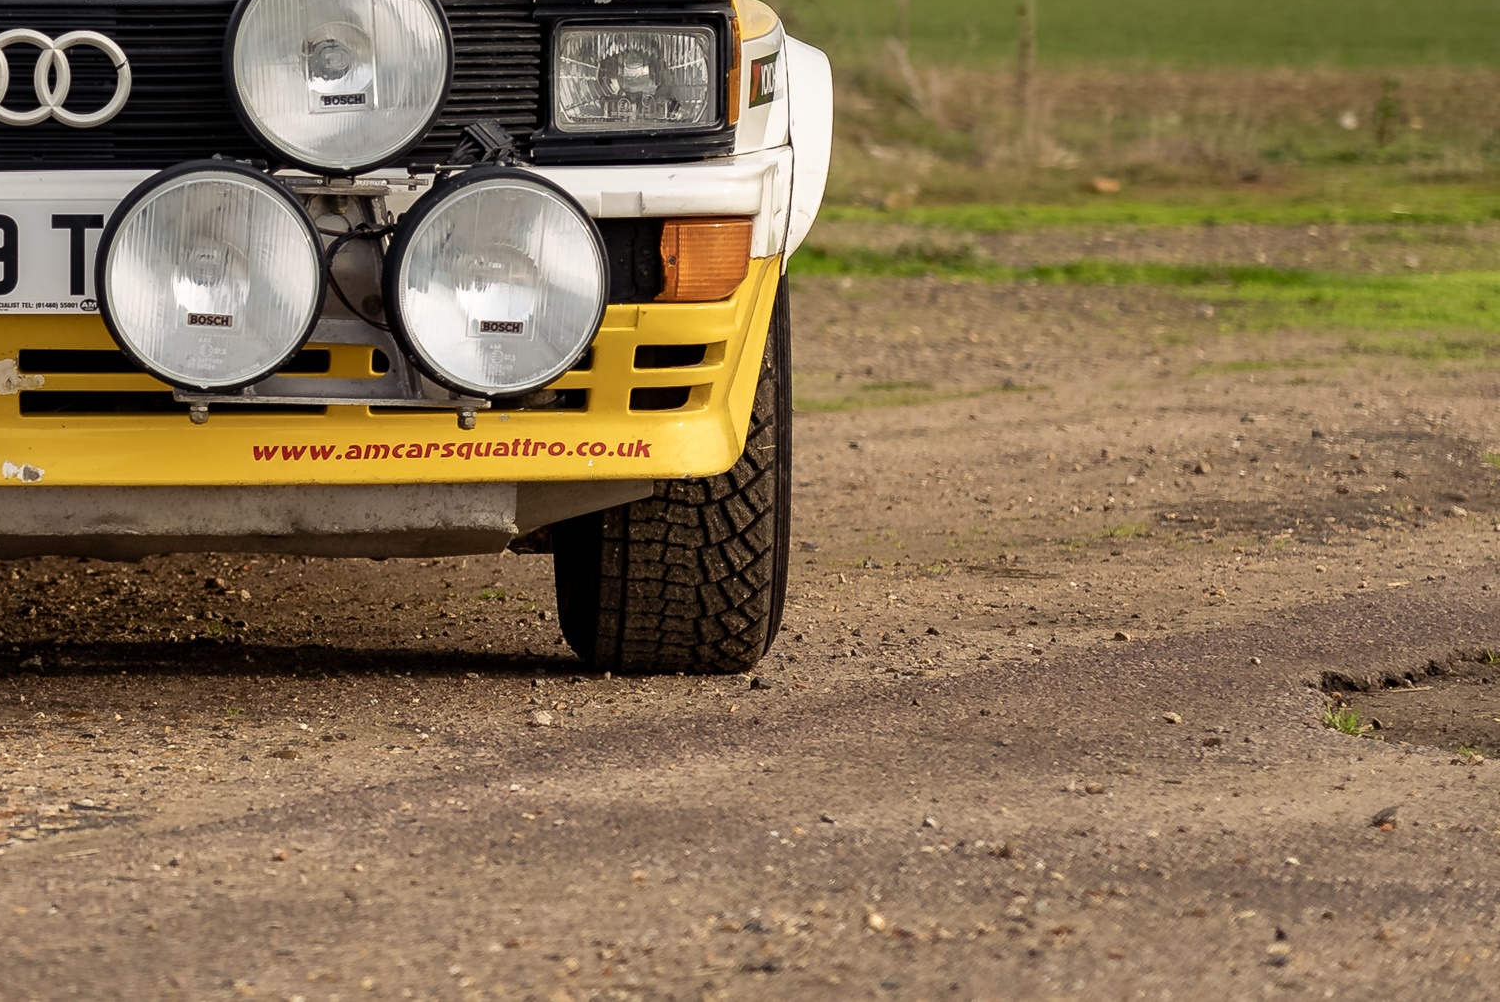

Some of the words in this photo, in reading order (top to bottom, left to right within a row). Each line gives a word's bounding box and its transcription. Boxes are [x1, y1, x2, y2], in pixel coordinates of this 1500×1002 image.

[324, 94, 363, 106] BOSCH
[51, 214, 104, 296] T
[190, 315, 229, 326] BOSCH
[483, 322, 520, 333] BOSCH
[252, 438, 653, 461] www.amcarsquattro.co.uk
